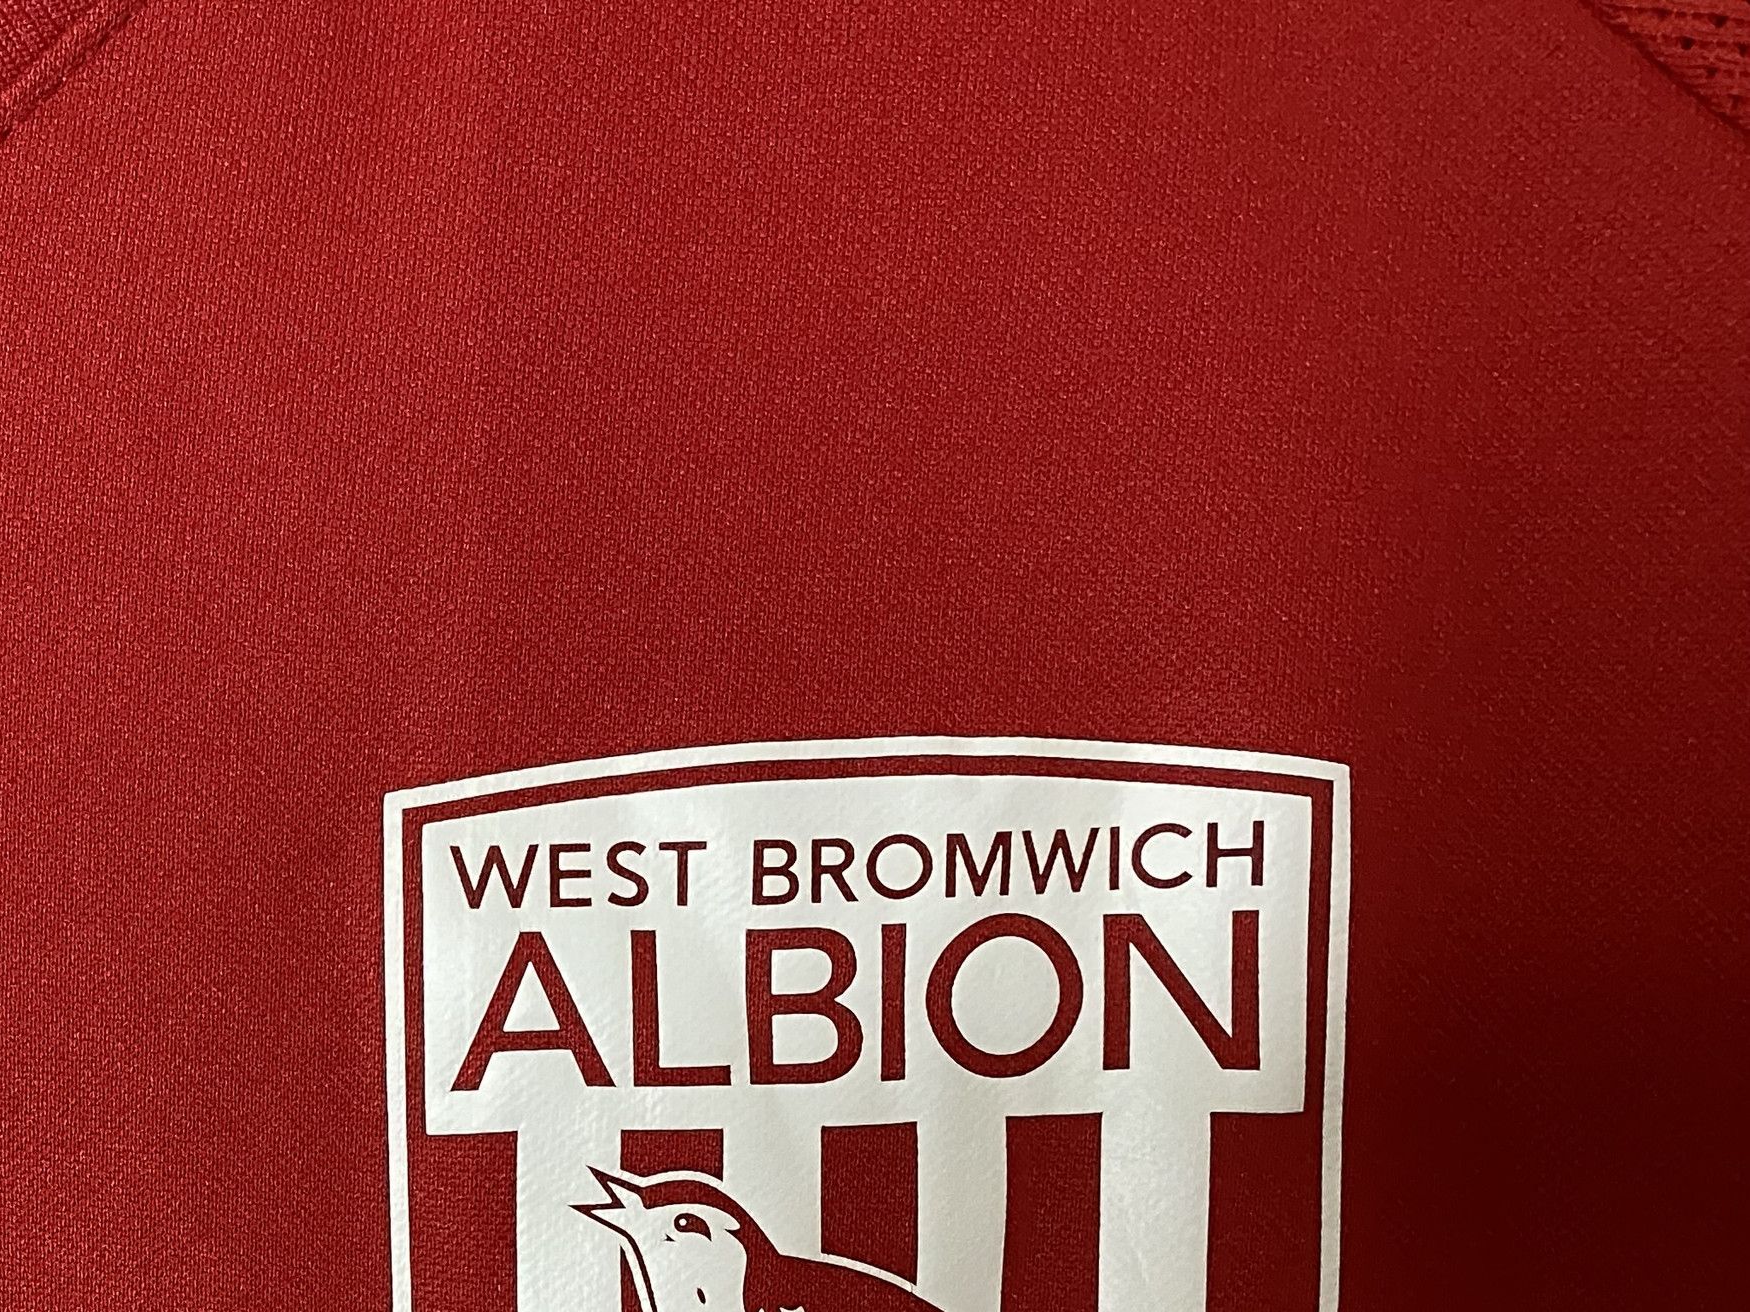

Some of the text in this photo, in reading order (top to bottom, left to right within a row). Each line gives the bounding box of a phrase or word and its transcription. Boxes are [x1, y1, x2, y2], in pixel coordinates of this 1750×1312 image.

[449, 820, 1265, 910] WEST BROMWICH
[449, 909, 1262, 1092] ALBION
